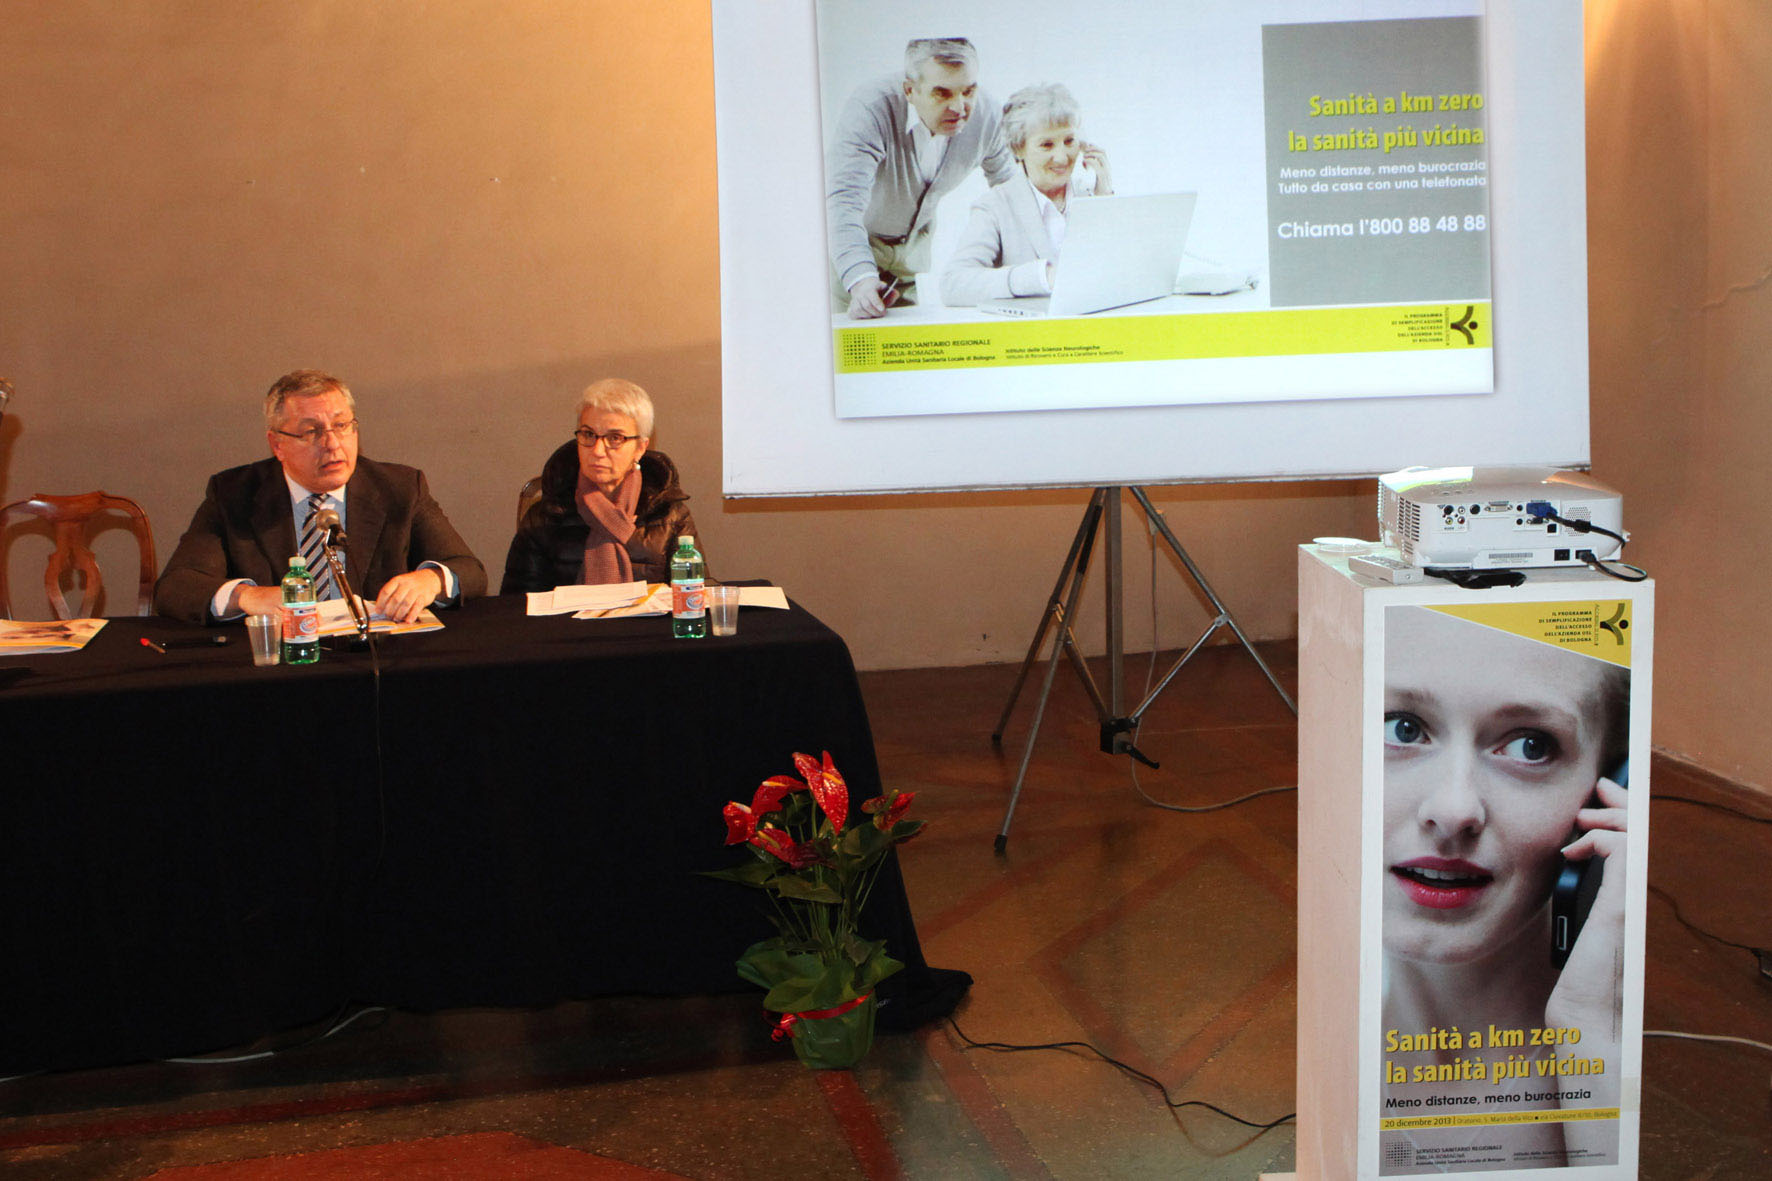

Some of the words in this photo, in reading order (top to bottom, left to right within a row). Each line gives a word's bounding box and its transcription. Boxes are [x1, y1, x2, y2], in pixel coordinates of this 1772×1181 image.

[1309, 92, 1378, 117] Sanità
[1383, 96, 1396, 114] a
[1400, 91, 1434, 112] km
[1438, 93, 1484, 111] zero
[1288, 130, 1308, 152] la
[1312, 127, 1379, 151] sanità
[1384, 125, 1418, 154] più
[1422, 124, 1484, 146] vicina
[1280, 167, 1316, 179] Meno
[1320, 164, 1374, 178] distanze,
[1378, 164, 1416, 175] meno
[1418, 160, 1486, 173] burocrazia
[1278, 182, 1307, 194] Tutto
[1311, 181, 1328, 192] da
[1332, 182, 1363, 192] casa
[1366, 181, 1391, 190] con
[1394, 180, 1418, 190] una
[1422, 175, 1487, 188] telefonata
[1278, 220, 1354, 238] Chiama
[1359, 218, 1404, 236] l'800
[1408, 216, 1430, 233] 88
[1436, 215, 1458, 232] 48
[1463, 214, 1486, 232] 88
[914, 340, 951, 348] SANITARIO
[1386, 1026, 1464, 1053] Sanità
[1468, 1028, 1482, 1049] a
[1488, 1024, 1524, 1048] km
[1530, 1025, 1582, 1046] zero
[1386, 1060, 1408, 1084] la
[1412, 1056, 1488, 1083] sanità
[1492, 1054, 1531, 1085] più
[1535, 1052, 1604, 1077] vicina
[1386, 1097, 1422, 1109] Meno
[1425, 1094, 1481, 1107] distanze,
[1484, 1092, 1522, 1104] meno
[1524, 1088, 1592, 1102] burocrazia
[1384, 1120, 1395, 1128] 20
[1396, 1118, 1432, 1128] dicembre
[1433, 1118, 1452, 1126] 2013
